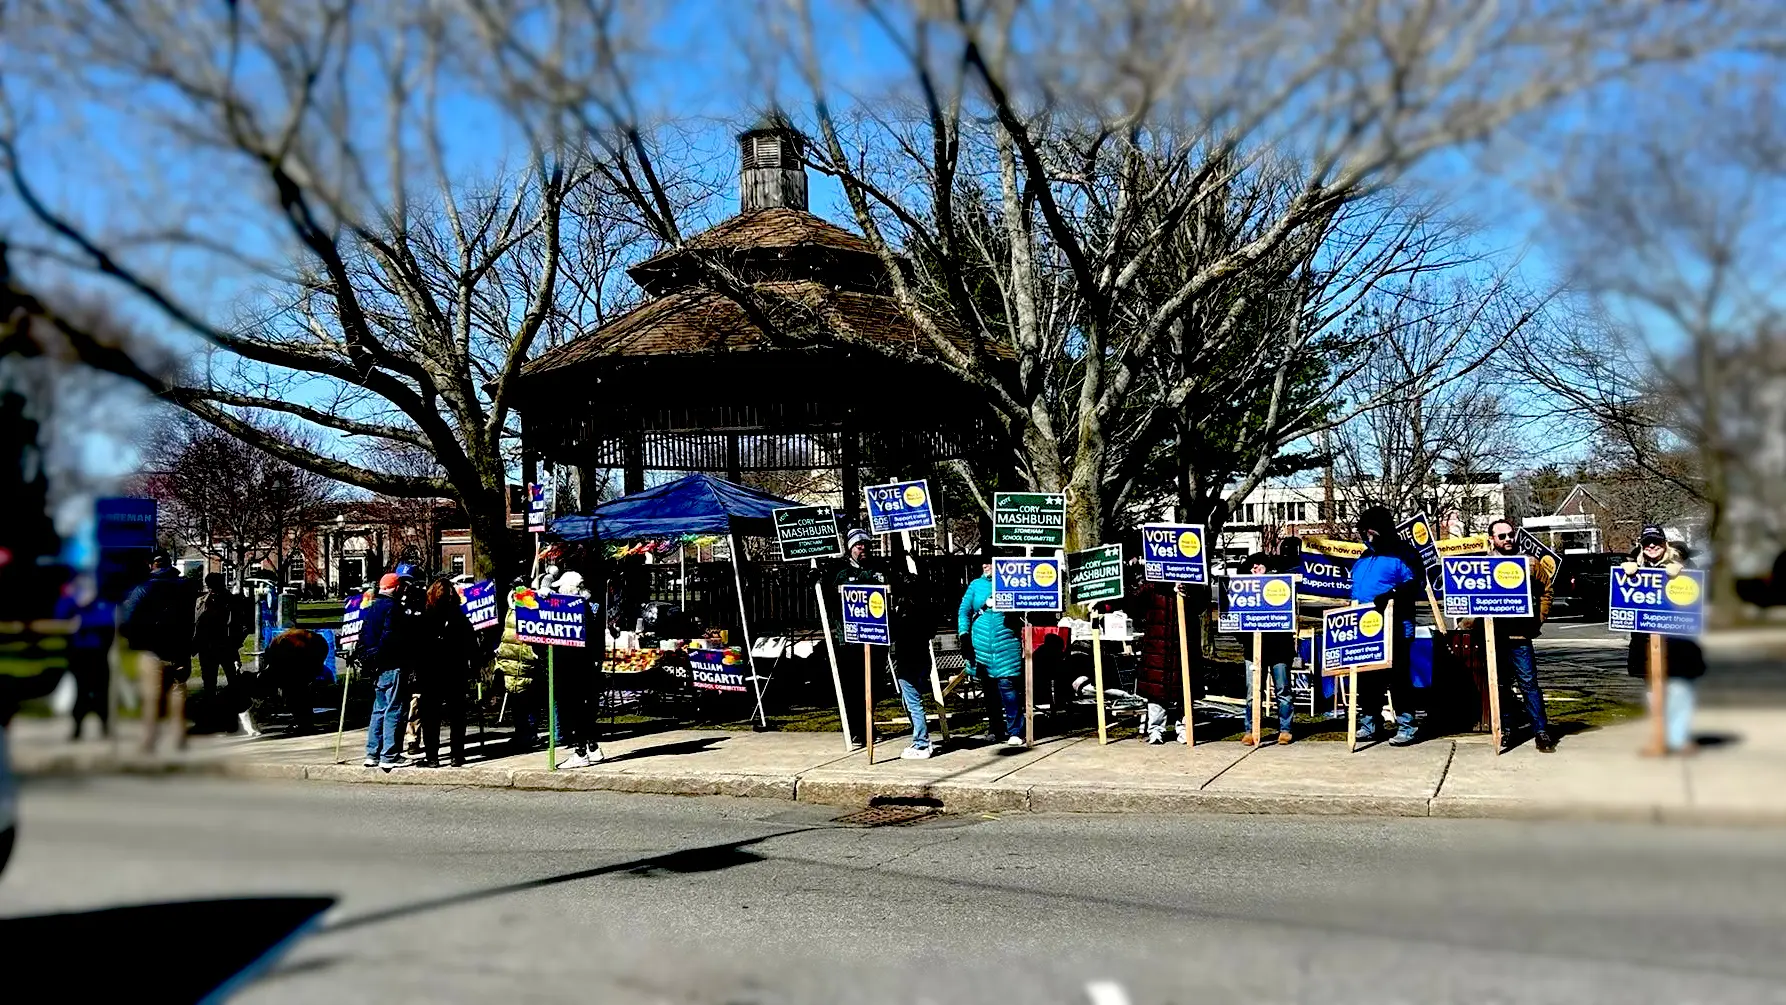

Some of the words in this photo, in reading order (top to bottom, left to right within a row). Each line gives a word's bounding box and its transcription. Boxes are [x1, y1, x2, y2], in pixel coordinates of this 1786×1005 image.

[869, 488, 901, 500] VOTE
[875, 499, 904, 512] Yes!
[874, 517, 888, 525] SOS
[998, 513, 1061, 525] MASHBURN
[781, 525, 834, 538] MASHBURN
[1145, 530, 1176, 543] VOTE
[1397, 527, 1412, 540] TE
[1149, 543, 1177, 557] Yes!
[1463, 541, 1484, 550] Strong
[1520, 533, 1542, 558] VOTE
[997, 563, 1031, 574] VOTE
[1085, 560, 1101, 569] CORY
[1146, 563, 1161, 572] SOS
[1304, 561, 1341, 577] VOTE
[1445, 561, 1491, 574] VOTE
[1001, 575, 1031, 588] Yes!
[1222, 580, 1261, 592] VOTE
[1303, 578, 1335, 588] Support
[1452, 575, 1492, 590] Yes!
[1615, 572, 1662, 588] VOTE
[844, 590, 867, 603] VOTE
[1227, 593, 1261, 607] Yes!
[1447, 597, 1468, 606] SOS
[1620, 587, 1662, 605] Yes!
[467, 595, 494, 611] WILLIAM
[539, 610, 582, 623] WILLIAM
[848, 604, 868, 618] Yes!
[1612, 610, 1634, 620] SOS
[1328, 613, 1358, 629] VOTE
[342, 620, 363, 636] FOGART
[517, 620, 582, 638] FOGARTY
[1330, 626, 1358, 643] Yes!
[518, 635, 545, 643] SCHOOL
[546, 638, 586, 647] COMMITTEE
[1326, 650, 1340, 659] SOS
[690, 661, 723, 672] WILLIAM
[693, 670, 743, 684] FOGARTY
